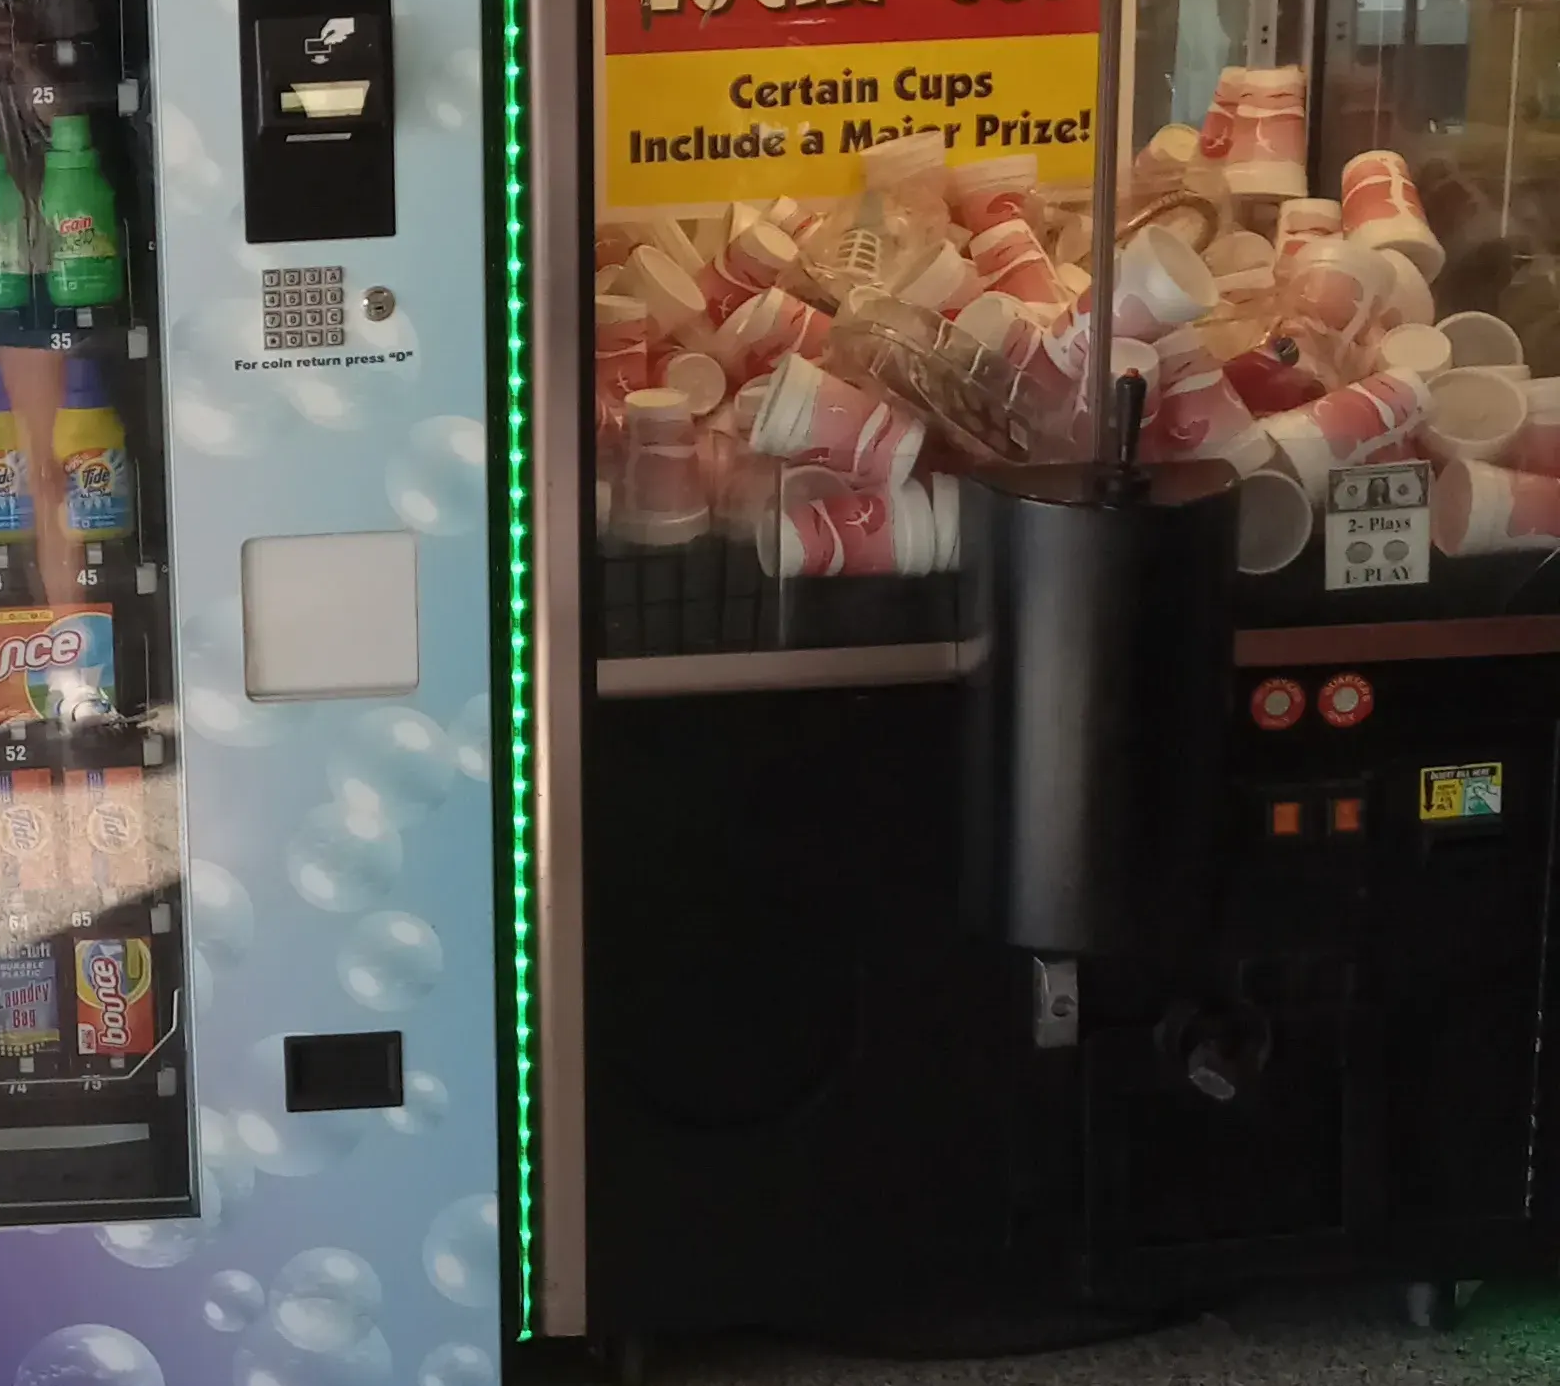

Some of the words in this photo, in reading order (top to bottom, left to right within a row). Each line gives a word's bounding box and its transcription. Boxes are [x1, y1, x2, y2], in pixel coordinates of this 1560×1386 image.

[32, 86, 55, 104] 25
[728, 67, 879, 110] Certain
[892, 66, 994, 107] Cups
[629, 121, 786, 164] Include
[800, 128, 825, 156] a
[975, 108, 1092, 148] Prize!
[50, 332, 72, 350] 35
[234, 359, 258, 371] For
[261, 357, 292, 370] coin
[296, 356, 341, 368] return
[345, 355, 385, 367] press
[81, 466, 110, 490] Tide
[1369, 516, 1411, 533] Plays
[76, 569, 99, 587] 45
[1364, 566, 1412, 583] PLAY
[5, 745, 27, 762] 52
[6, 809, 40, 851] Tide
[8, 914, 29, 931] 64
[71, 911, 92, 928] 65
[91, 955, 132, 1048] bounce
[12, 1008, 37, 1029] Bag
